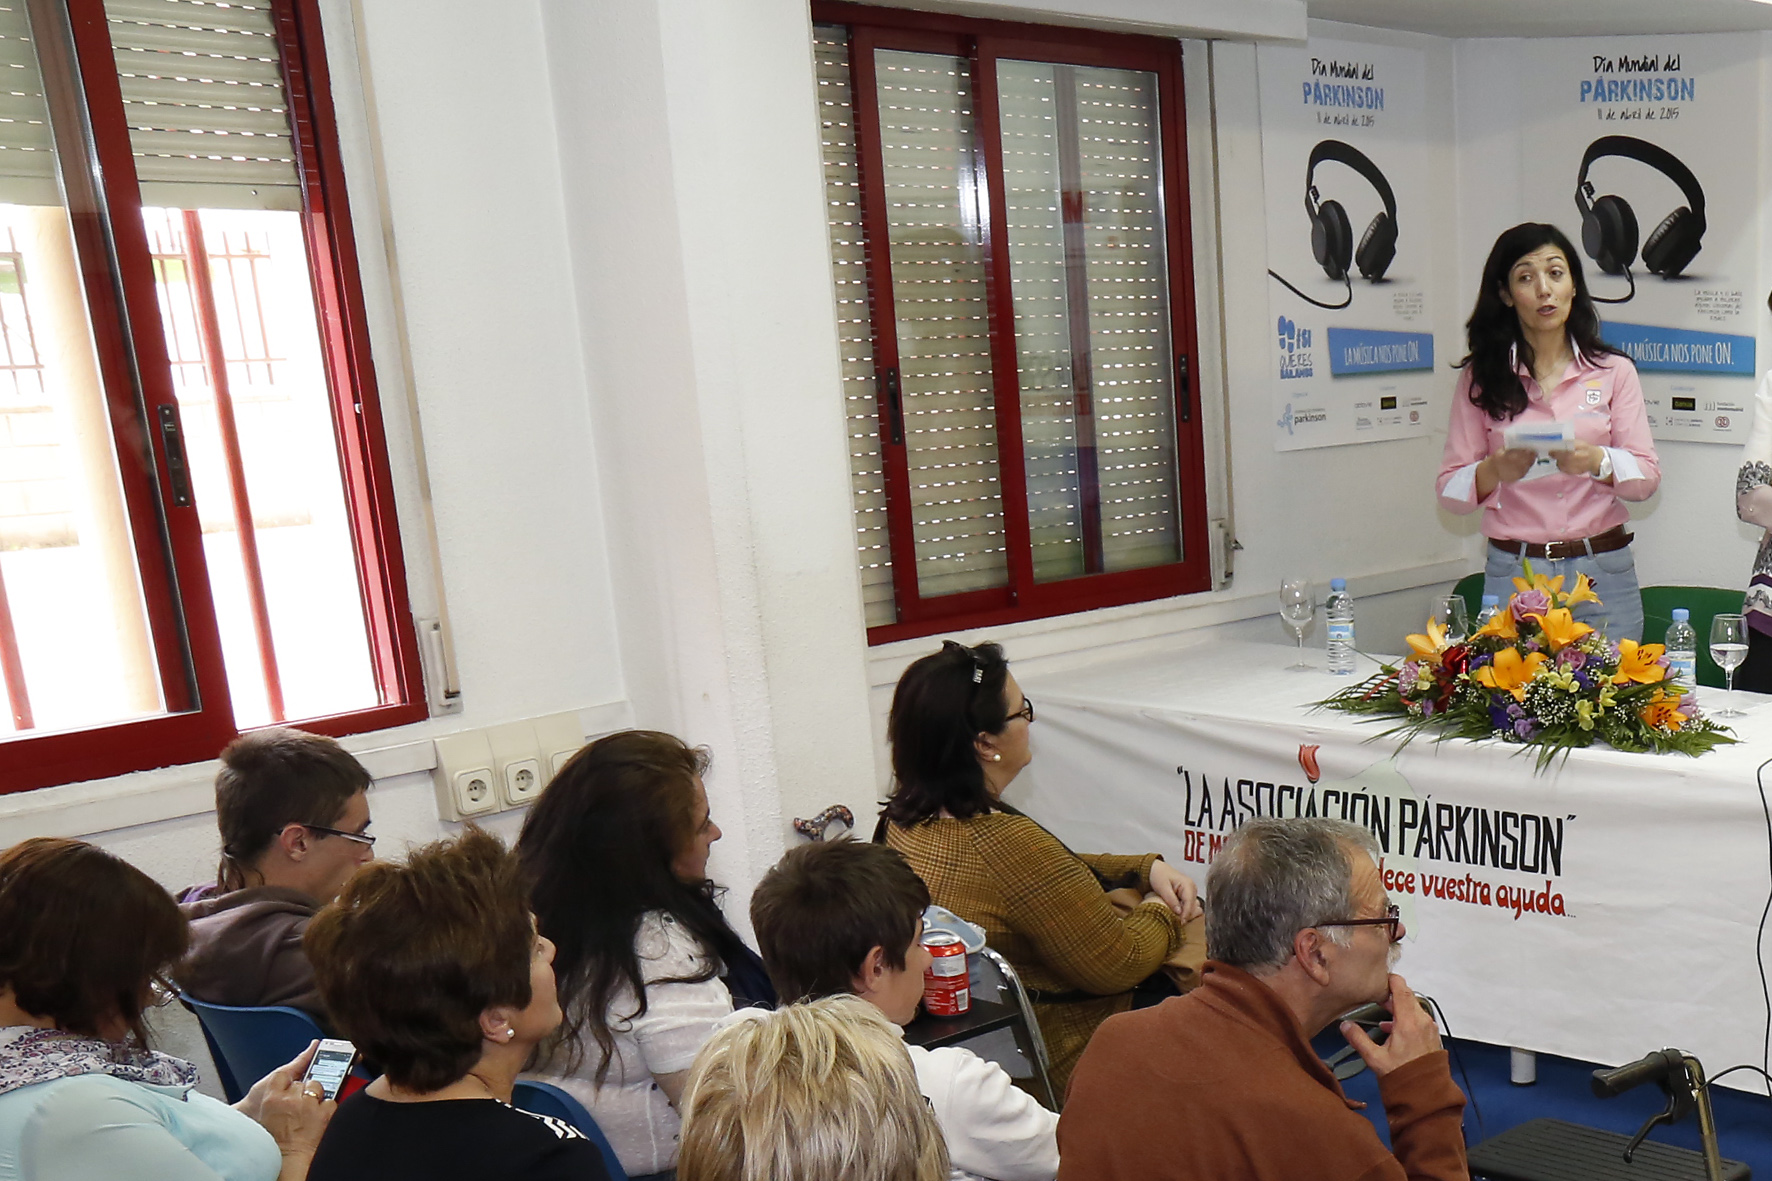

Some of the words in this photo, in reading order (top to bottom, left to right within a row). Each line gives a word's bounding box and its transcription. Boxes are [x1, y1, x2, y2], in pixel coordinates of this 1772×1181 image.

[1618, 55, 1659, 73] Mundial
[1663, 53, 1680, 72] del
[1303, 79, 1384, 111] PÁRKINSON
[1580, 75, 1695, 102] PÁRKINSON
[1605, 108, 1616, 120] de
[1645, 107, 1655, 120] de
[1660, 106, 1679, 120] 2015
[1634, 338, 1670, 363] MÚSICA
[1671, 343, 1690, 363] NOS
[1691, 343, 1714, 365] PONE
[1294, 413, 1327, 426] parkinson
[1184, 829, 1205, 864] DE
[1420, 872, 1492, 907] vuestra
